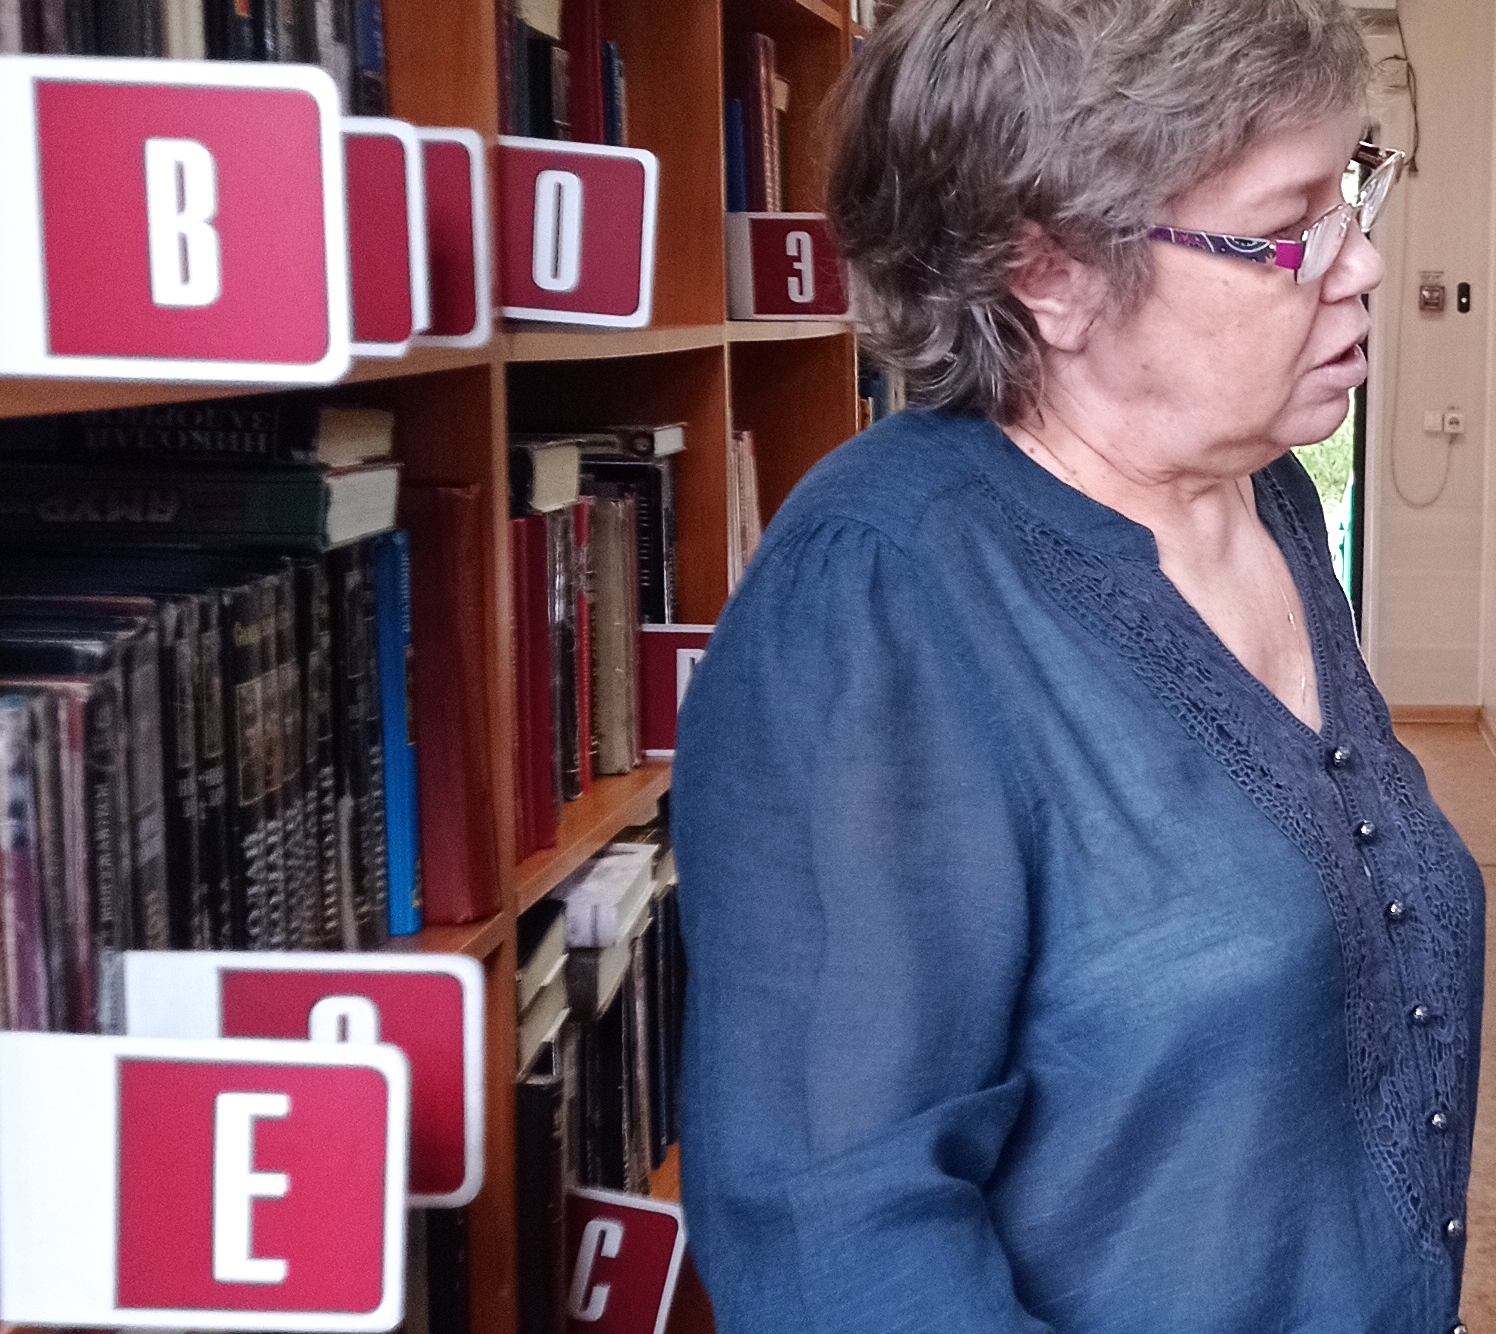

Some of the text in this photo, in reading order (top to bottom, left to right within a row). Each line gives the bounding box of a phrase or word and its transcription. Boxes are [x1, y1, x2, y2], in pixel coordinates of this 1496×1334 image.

[144, 136, 222, 309] В
[532, 169, 583, 293] О
[212, 1090, 291, 1285] Е
[571, 1219, 623, 1322] С
